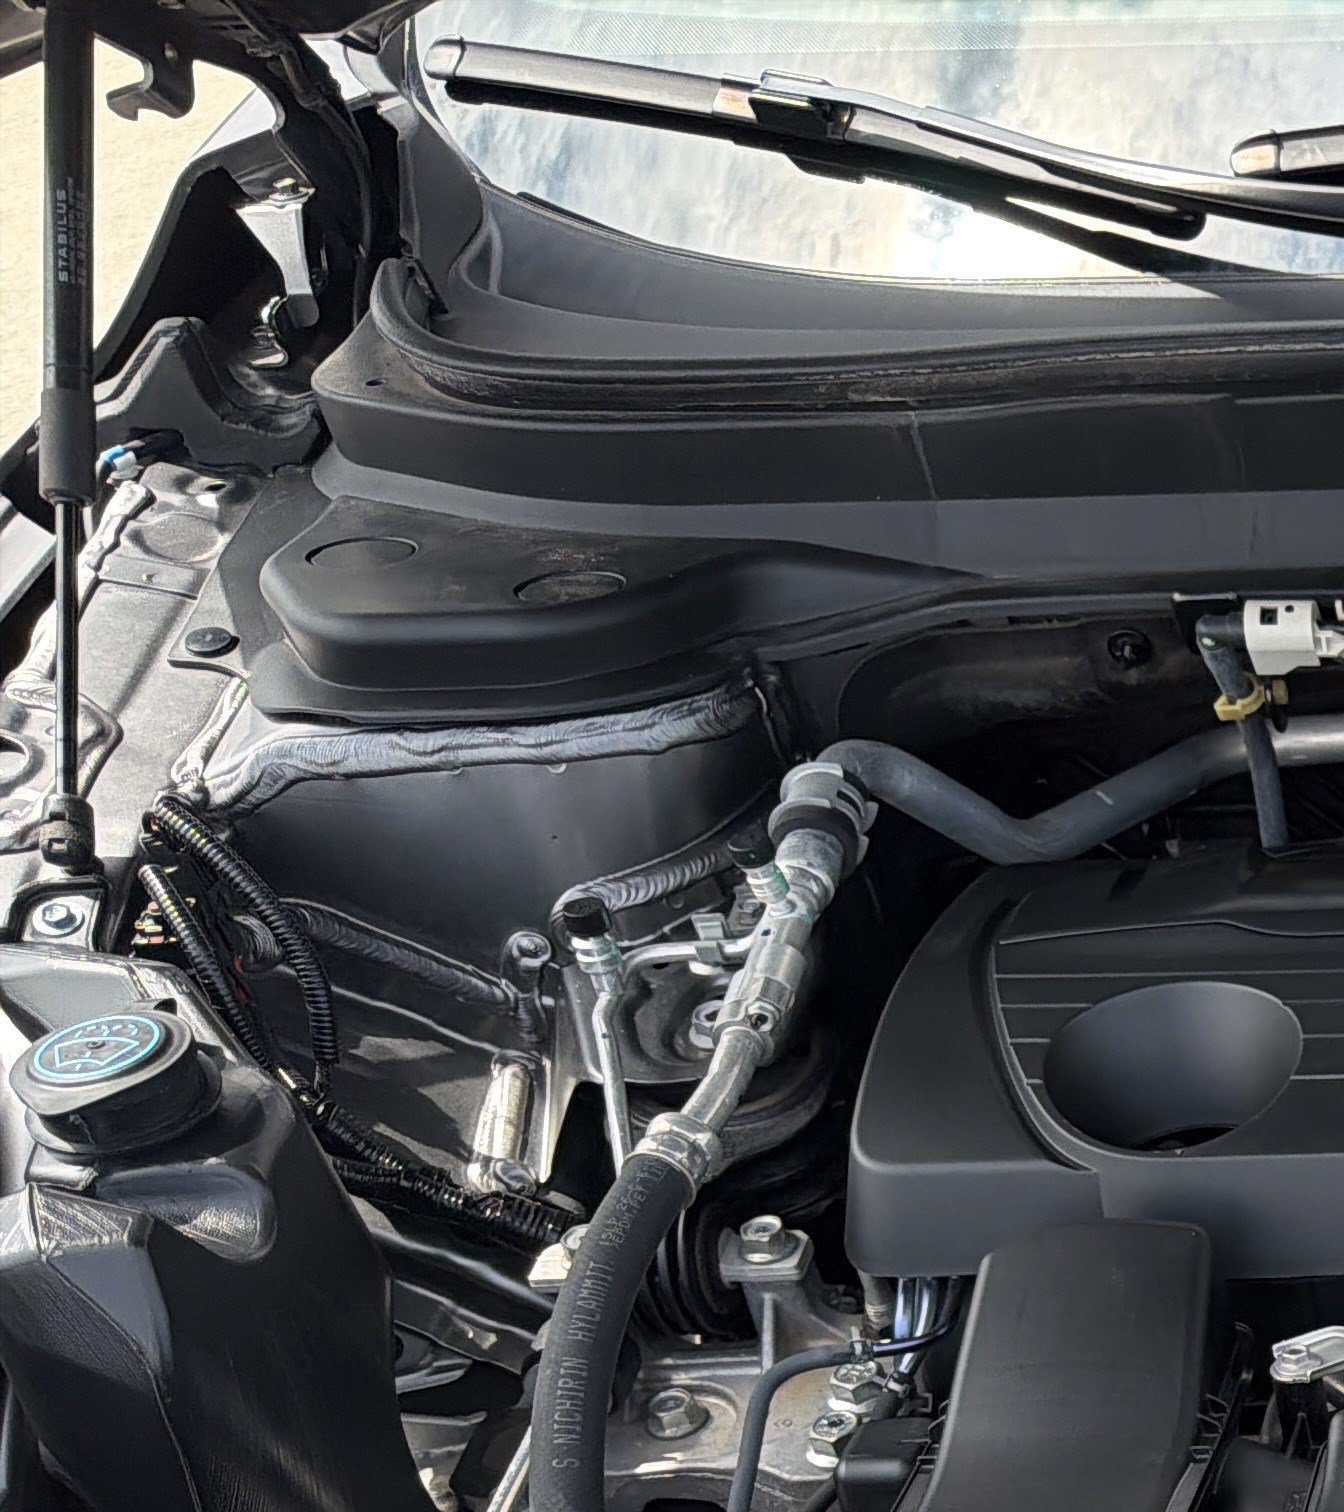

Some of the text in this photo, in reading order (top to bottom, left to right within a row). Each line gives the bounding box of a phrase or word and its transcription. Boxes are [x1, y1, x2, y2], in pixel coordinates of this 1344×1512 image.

[57, 189, 69, 282] STABILUS
[568, 1260, 615, 1342] HYLAMMIT
[553, 1356, 590, 1445] NICHIRIN
